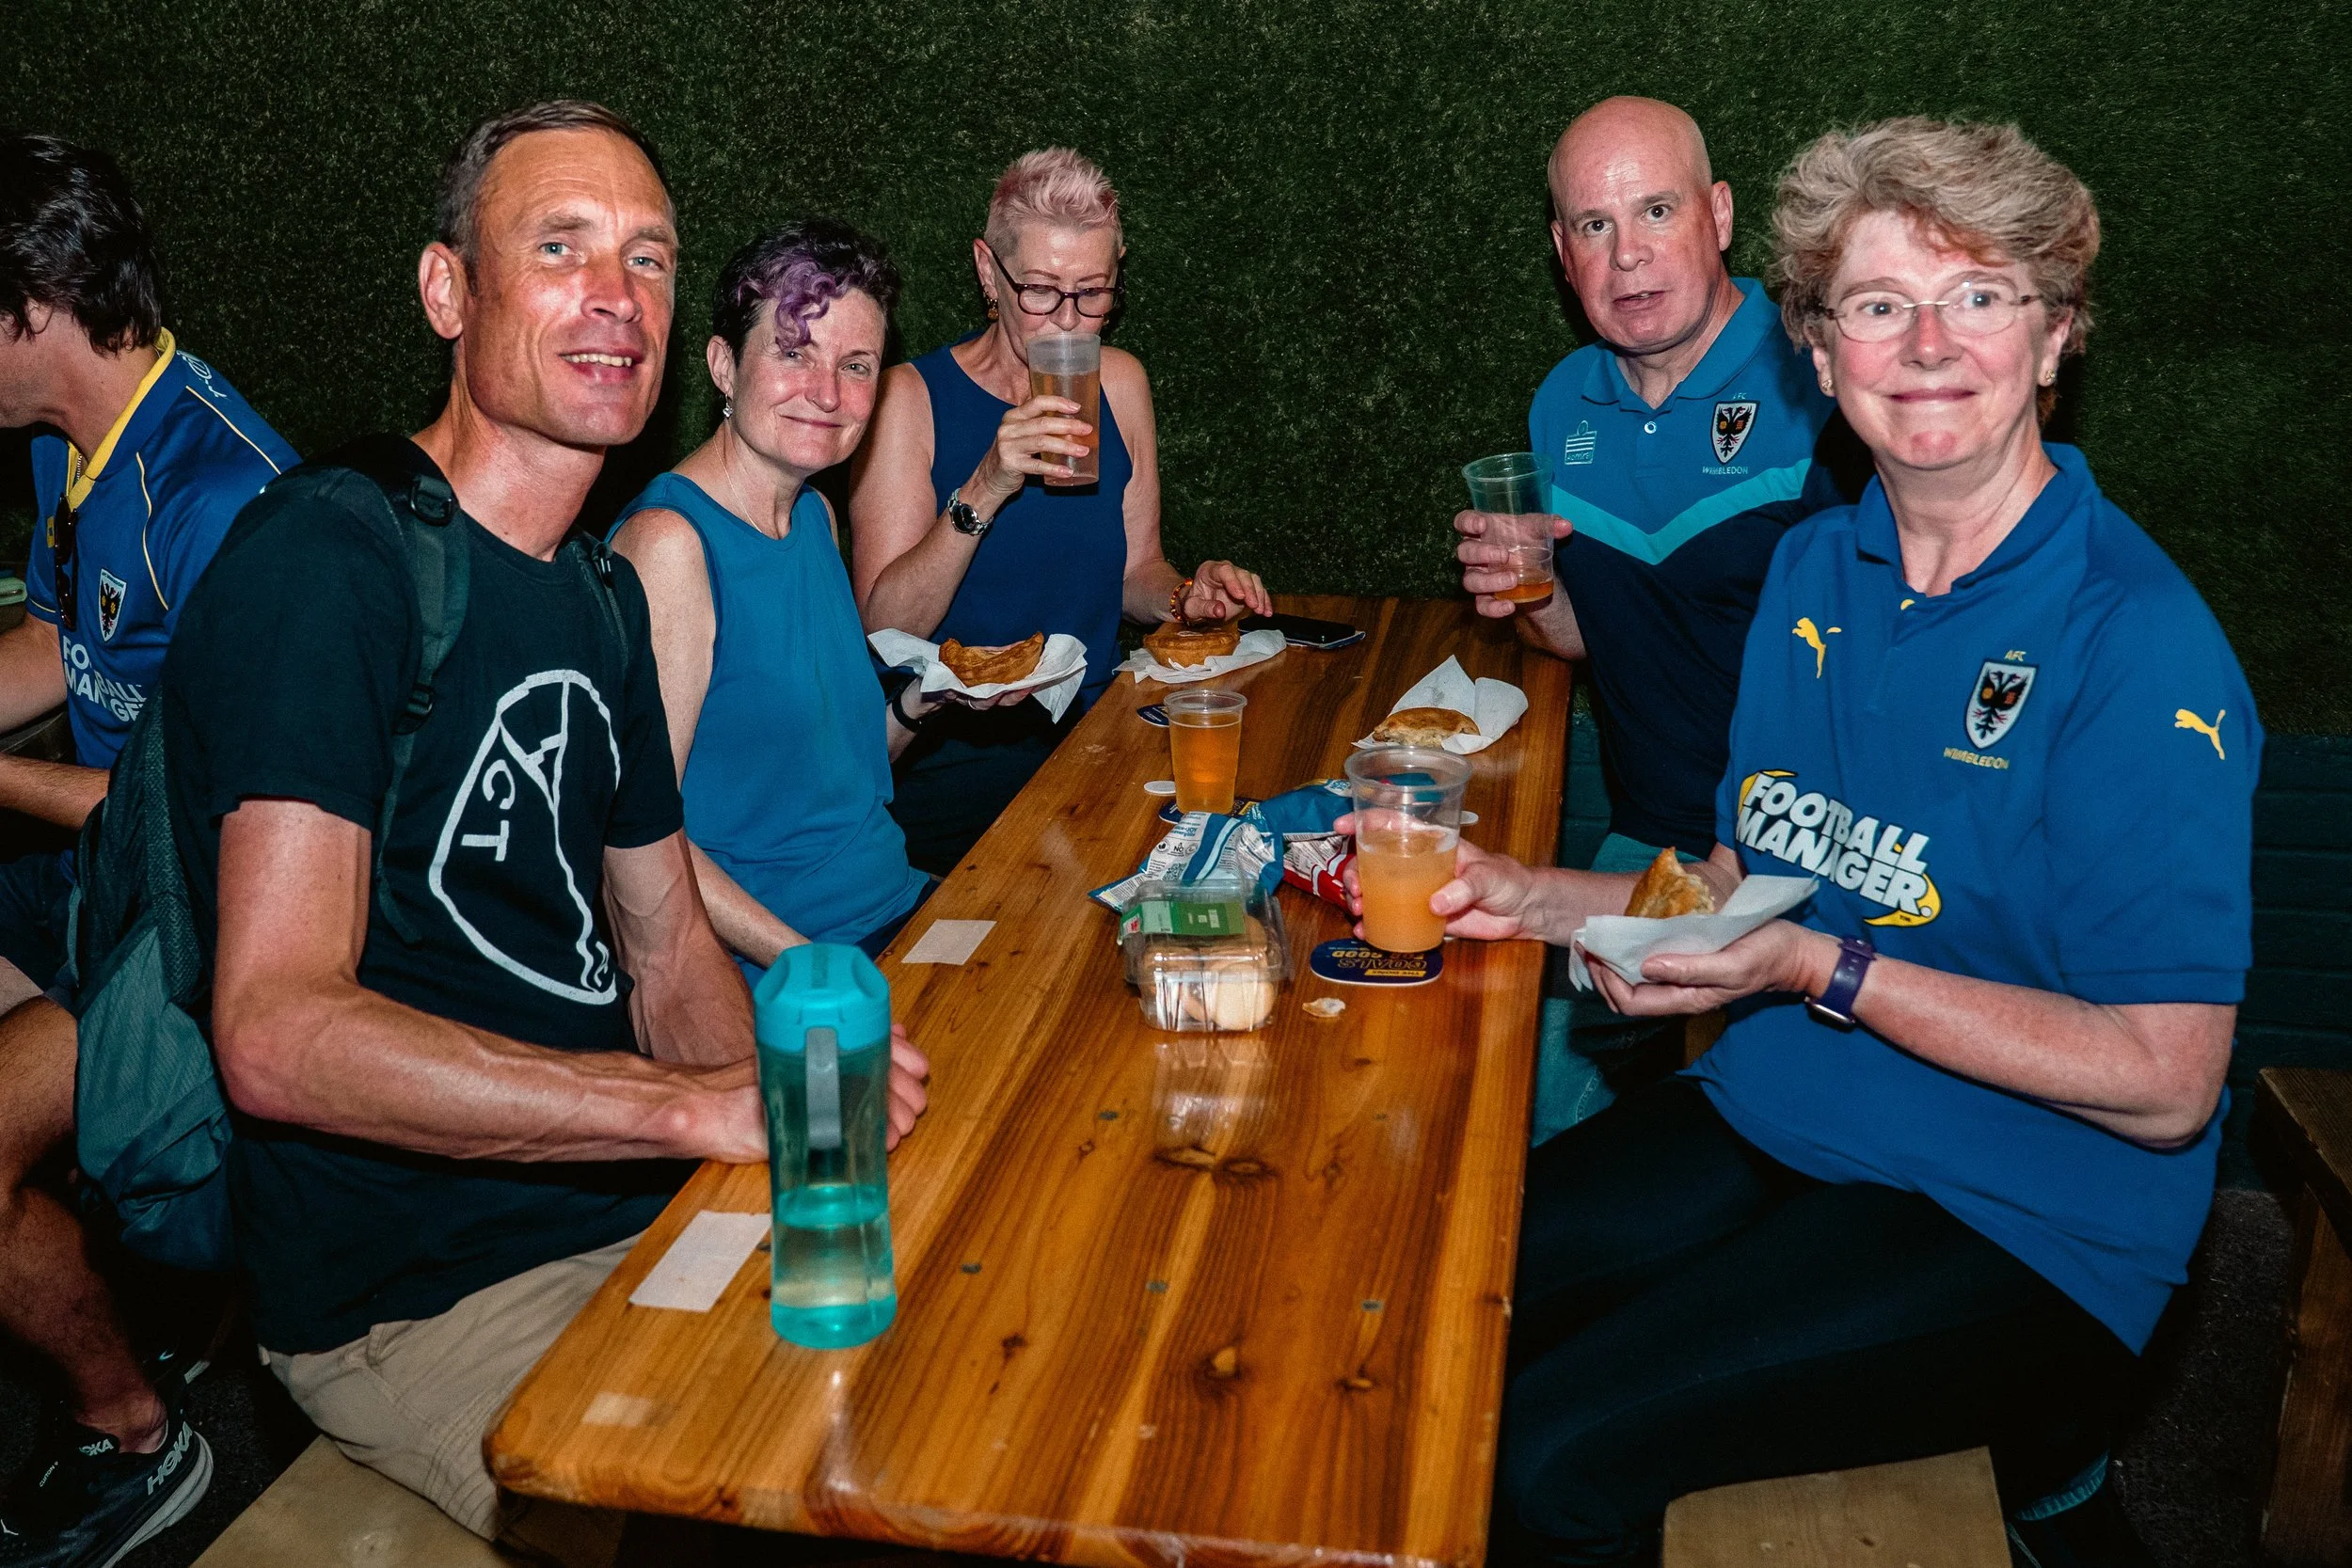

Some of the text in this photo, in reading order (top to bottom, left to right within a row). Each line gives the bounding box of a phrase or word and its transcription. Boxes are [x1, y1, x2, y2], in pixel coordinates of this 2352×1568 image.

[1702, 466, 1749, 475] WIMBLEDON
[2004, 650, 2026, 661] AFC
[63, 635, 147, 703] FOBALL
[1943, 747, 2010, 769] WIMBLEDON
[1743, 772, 1931, 876] FOOTBALL
[79, 1438, 114, 1456] OKA
[147, 1421, 194, 1496] HOKA
